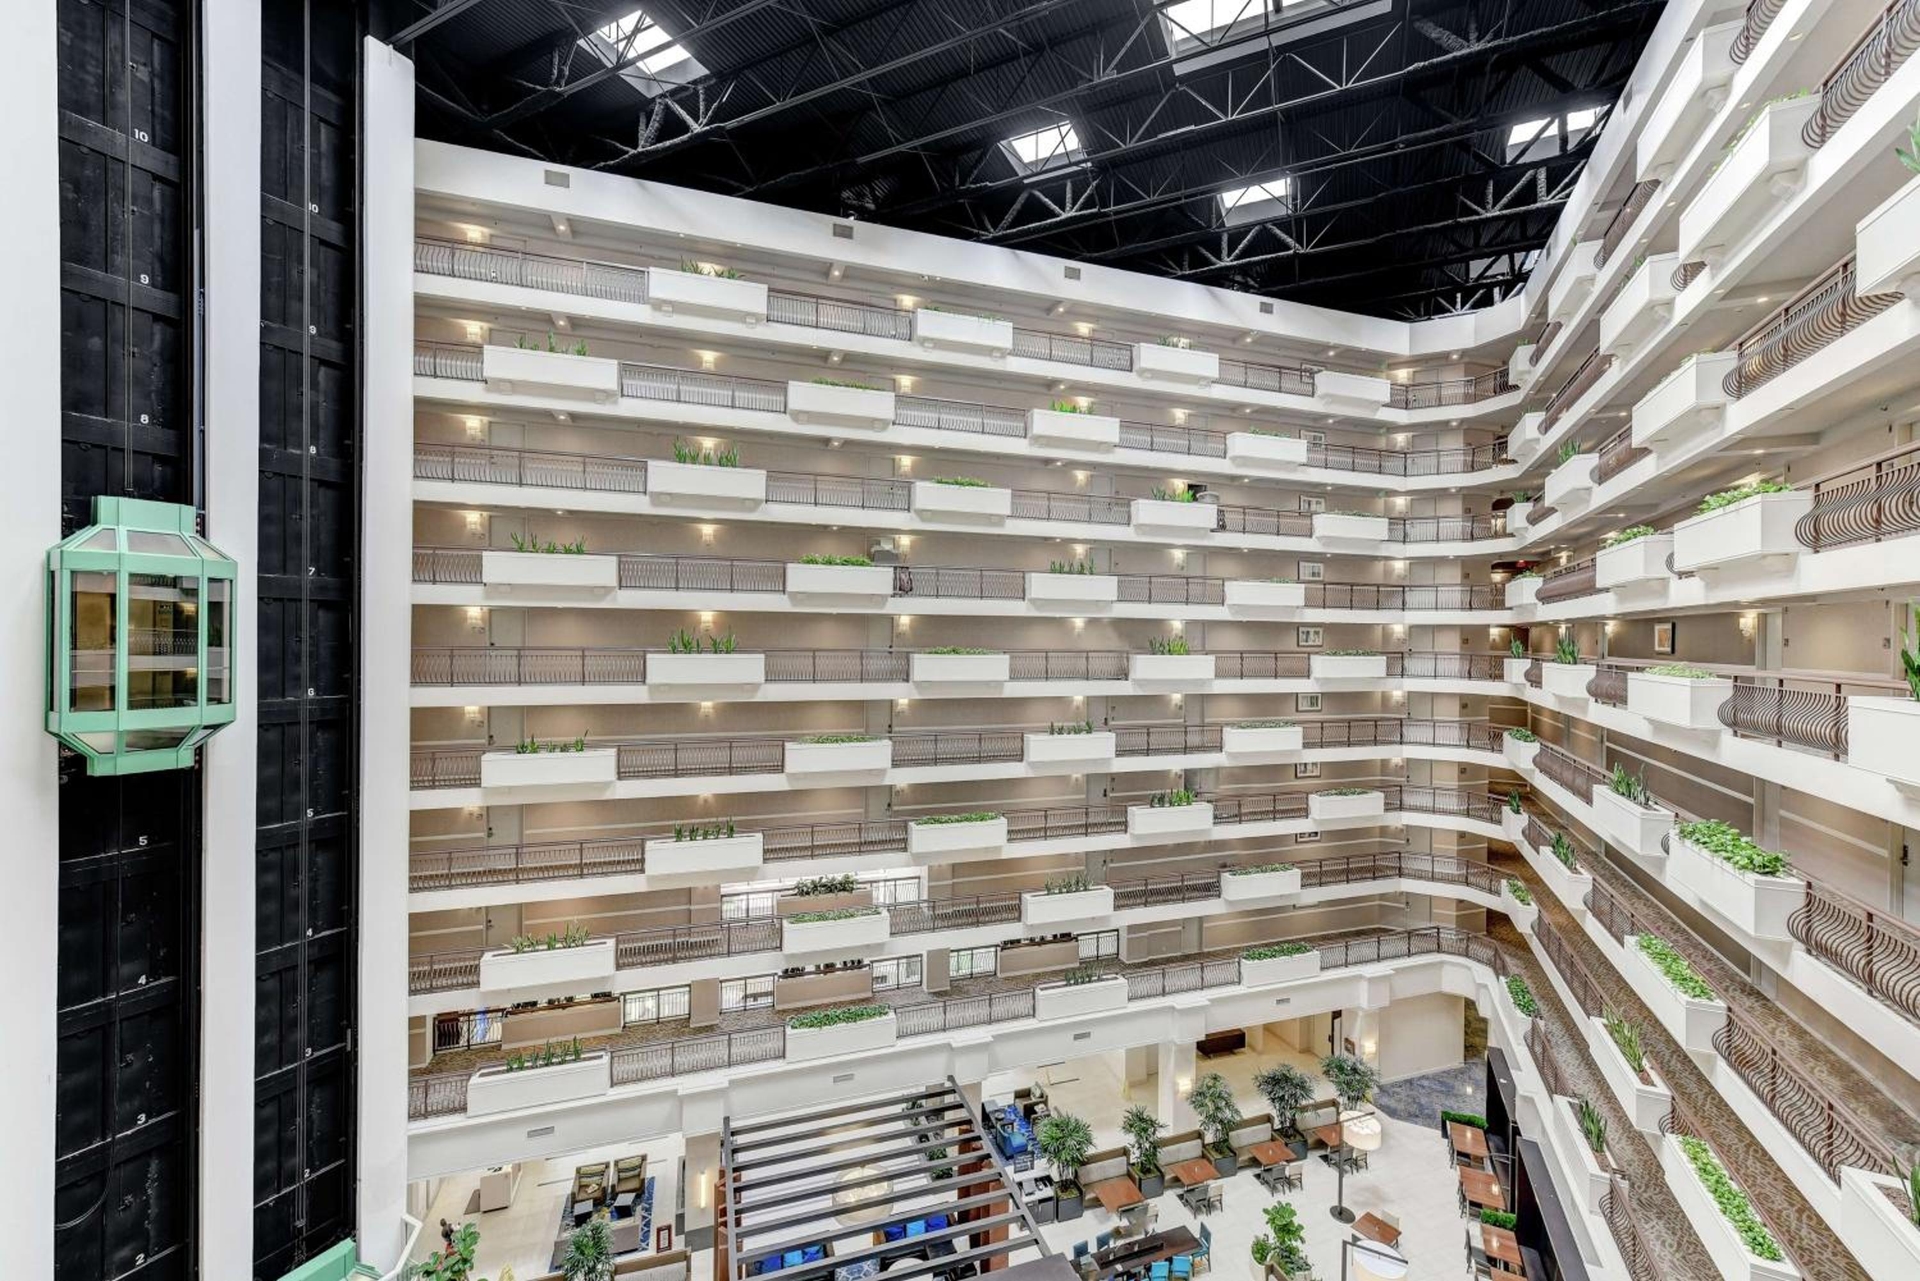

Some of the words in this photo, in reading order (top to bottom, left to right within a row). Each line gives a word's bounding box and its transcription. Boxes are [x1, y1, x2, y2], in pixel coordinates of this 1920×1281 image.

[134, 128, 148, 142] 10
[140, 274, 149, 284] 9
[140, 414, 149, 424] 8
[310, 445, 316, 454] 8
[308, 567, 315, 575] 7
[307, 808, 314, 817] 5
[139, 835, 148, 845] 5
[306, 927, 312, 937] 4
[138, 974, 146, 985] 4
[305, 1047, 312, 1057] 3
[137, 1113, 146, 1124] 3
[304, 1168, 310, 1178] 2
[135, 1253, 145, 1265] 2
